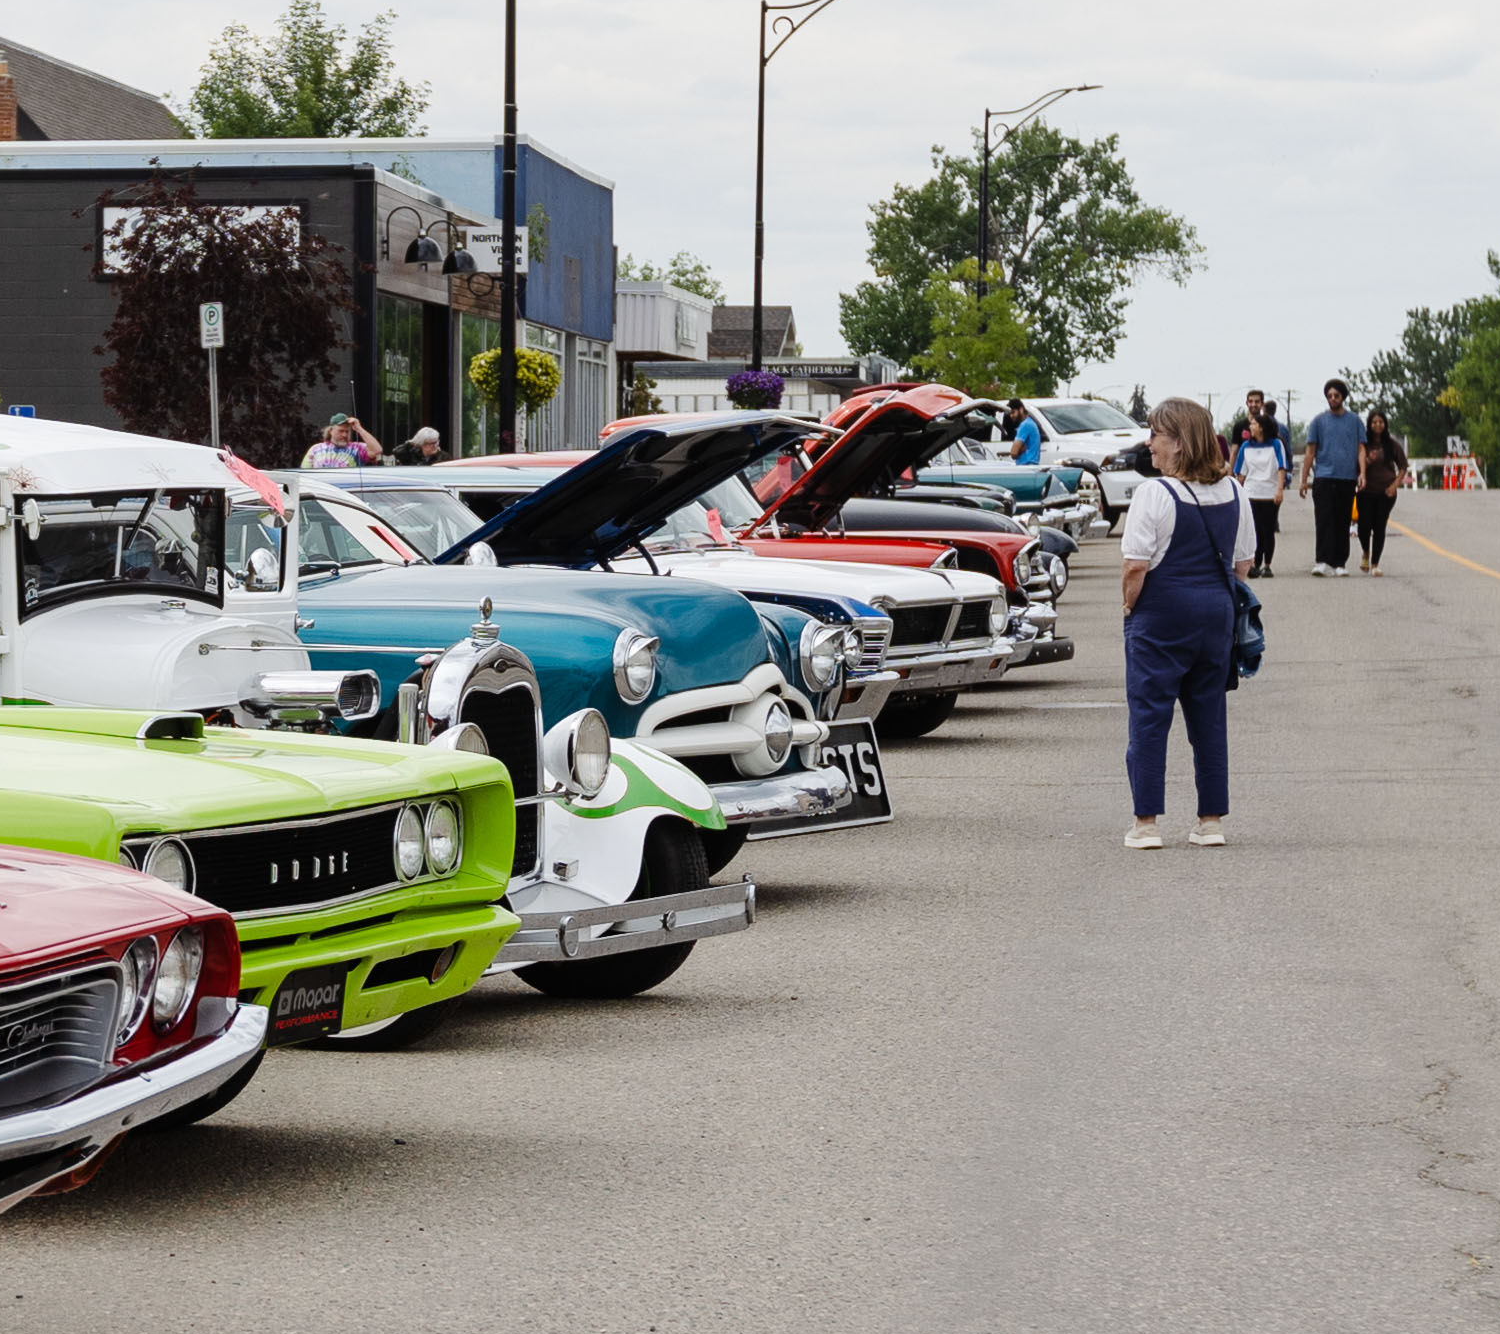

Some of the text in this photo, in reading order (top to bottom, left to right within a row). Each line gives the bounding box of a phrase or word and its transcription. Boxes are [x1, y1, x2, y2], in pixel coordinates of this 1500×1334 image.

[472, 234, 522, 243] NORTHN
[491, 245, 522, 254] VIN
[497, 256, 522, 265] CE
[271, 851, 349, 884] DODGE
[275, 1010, 338, 1030] PERFORMANCE
